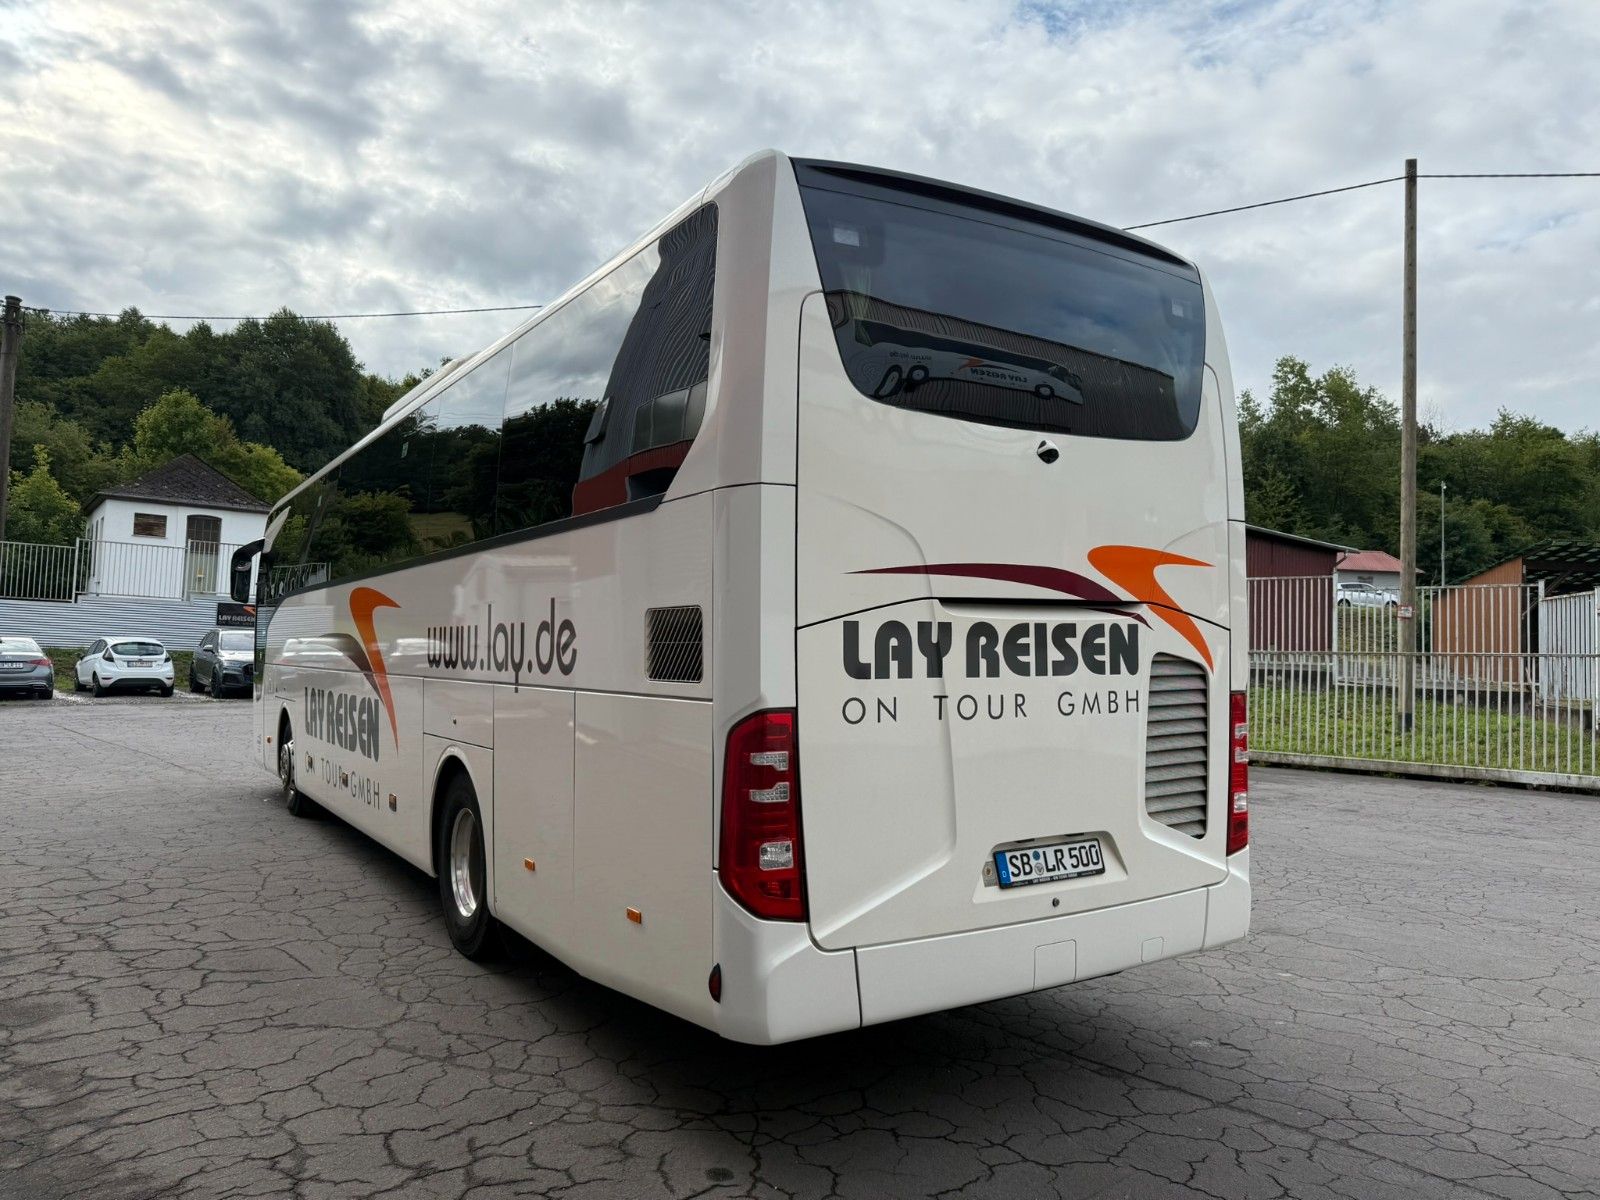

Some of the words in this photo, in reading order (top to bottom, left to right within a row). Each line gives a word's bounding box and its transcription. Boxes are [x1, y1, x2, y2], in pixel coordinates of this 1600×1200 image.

[428, 597, 577, 693] www.lay.de
[843, 620, 952, 680] LAY
[965, 621, 1139, 678] REISEN
[304, 686, 325, 741] LAY
[326, 690, 380, 763] REISEN
[842, 696, 897, 725] ON
[933, 693, 1027, 721] TOUR
[1057, 690, 1140, 716] GMBH
[350, 770, 380, 811] GMBH
[1009, 853, 1033, 877] SB
[1042, 849, 1067, 872] LR
[1069, 844, 1100, 869] 500
